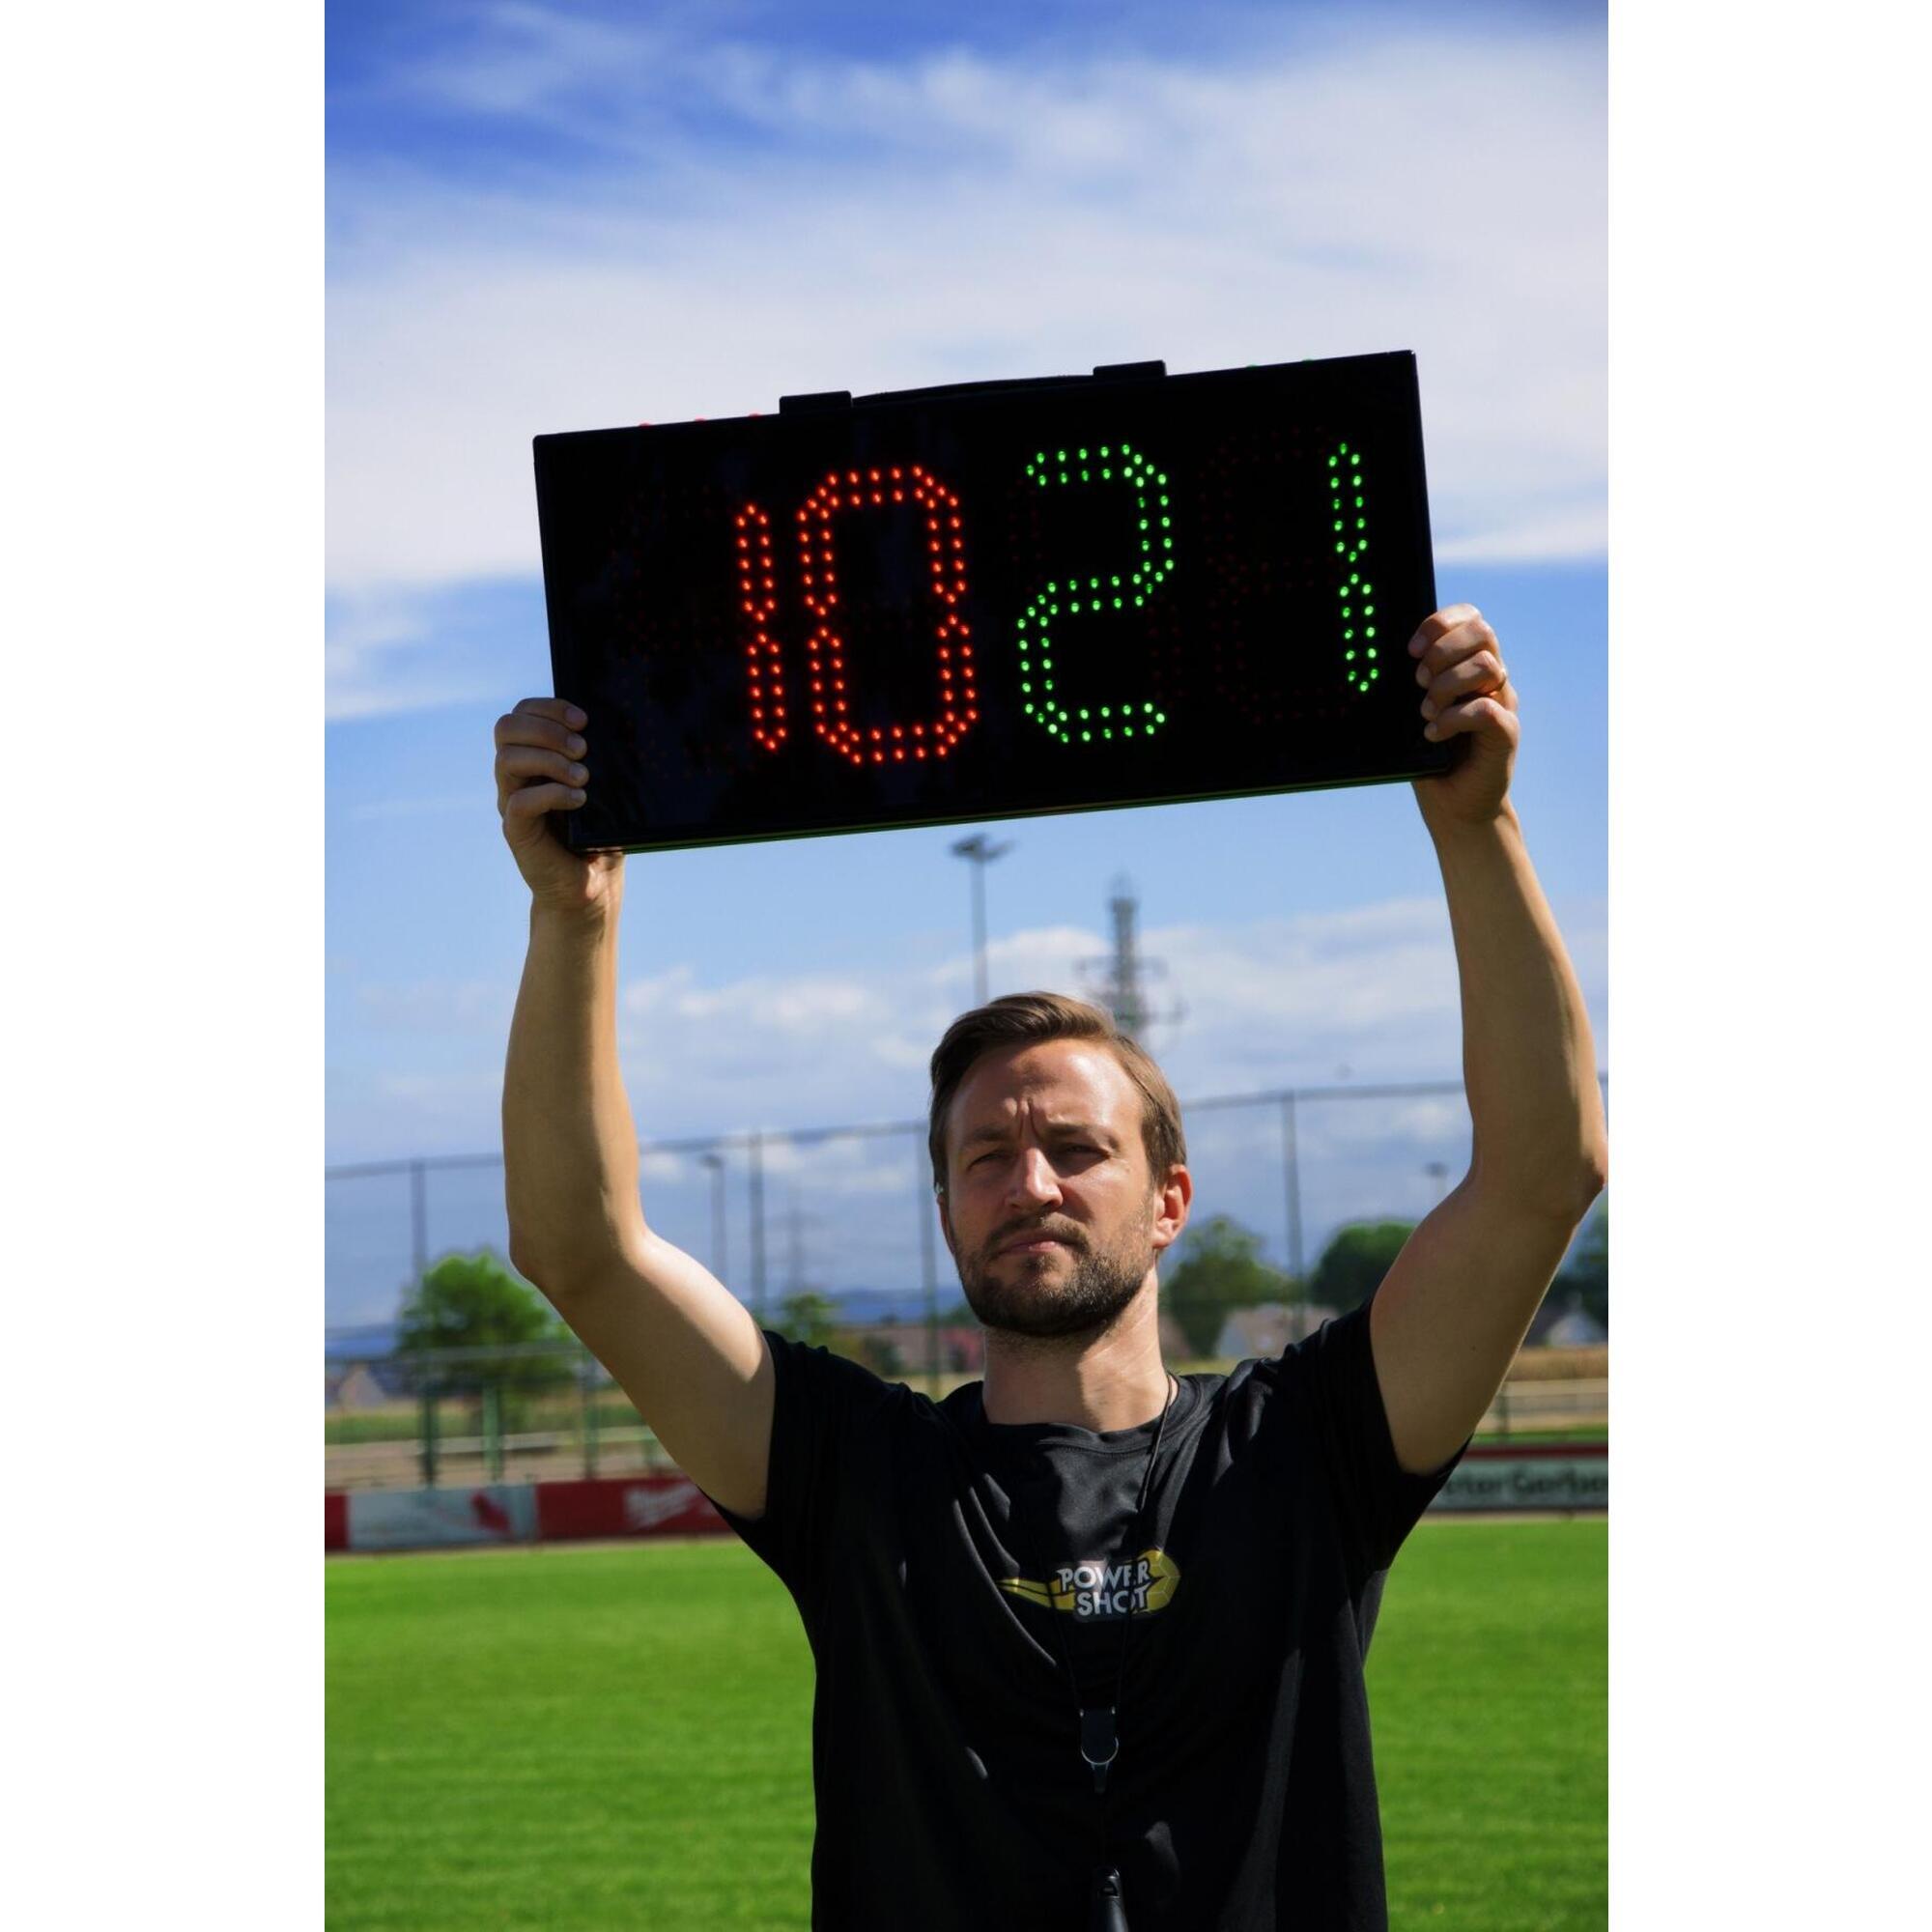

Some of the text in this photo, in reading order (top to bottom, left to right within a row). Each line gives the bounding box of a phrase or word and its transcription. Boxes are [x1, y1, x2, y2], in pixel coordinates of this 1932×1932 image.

[734, 441, 1379, 764] 10 21
[1056, 1560, 1151, 1592] POWER
[1076, 1581, 1151, 1616] SHOT
